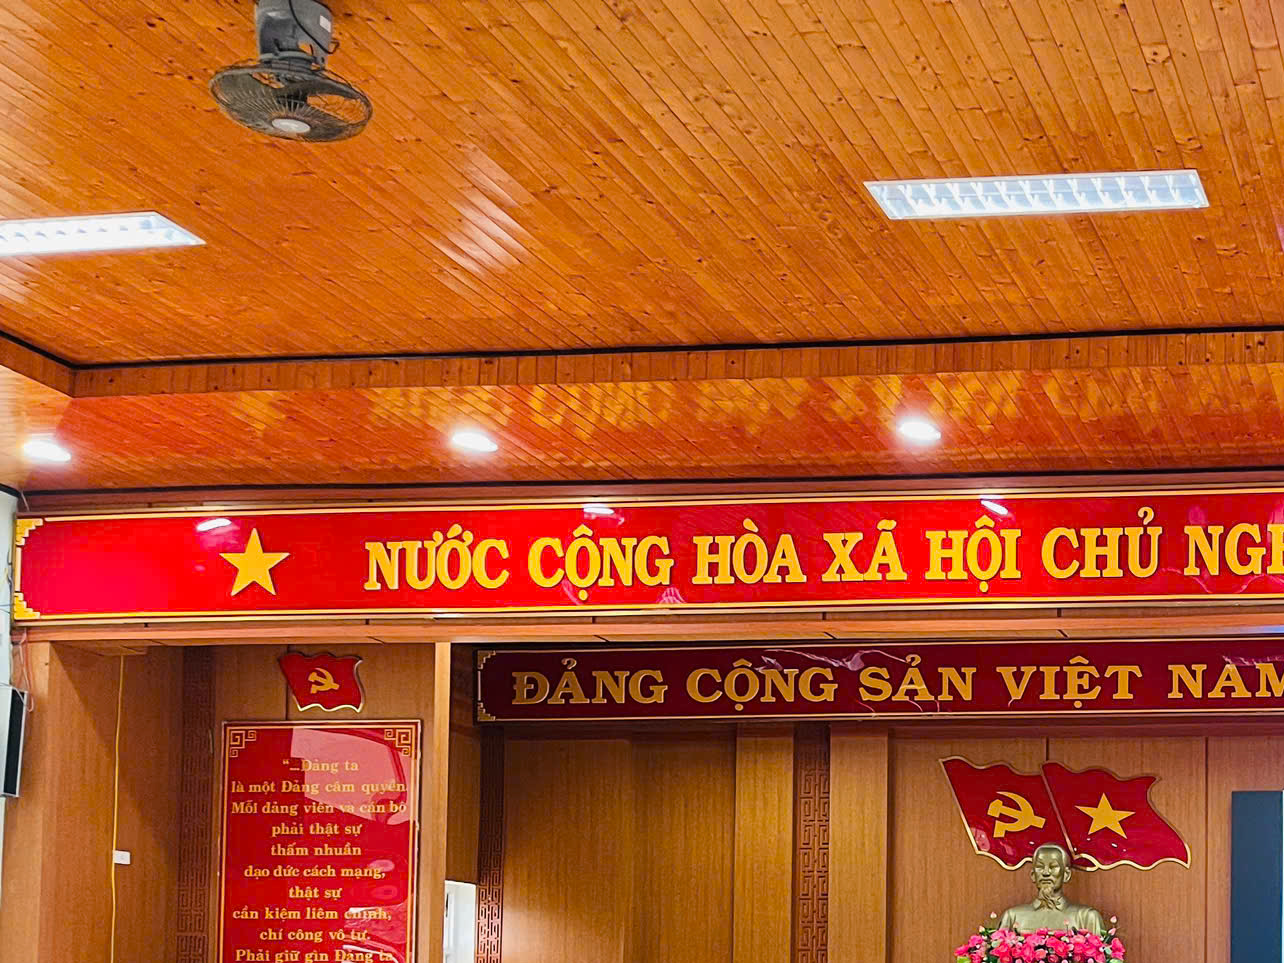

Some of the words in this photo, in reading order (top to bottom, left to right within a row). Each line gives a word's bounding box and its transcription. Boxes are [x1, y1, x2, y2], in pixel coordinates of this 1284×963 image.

[364, 523, 509, 591] NƯỚC
[528, 525, 673, 600] CỘNG
[692, 518, 806, 584] HÒA
[821, 519, 907, 582] XÃ
[925, 515, 1022, 593] HỘI
[1041, 506, 1163, 578] CHỦ
[512, 657, 668, 705] ĐẢNG
[686, 658, 838, 711] CỘNG
[857, 653, 977, 703] SẢN
[998, 655, 1142, 708] VIỆT
[231, 781, 245, 792] là
[248, 781, 276, 795] một
[281, 780, 320, 795] Đảng
[232, 800, 257, 813] Mỗi
[262, 802, 298, 816] đảng
[272, 822, 304, 837] phải
[310, 823, 339, 836] thật
[345, 824, 362, 836] sự
[271, 842, 308, 856] thấm
[314, 842, 361, 856] nhuần
[244, 865, 270, 879] đạo
[274, 865, 300, 876] đức
[303, 865, 336, 876] cách
[341, 868, 385, 879] mạng,
[289, 886, 319, 900] thật
[324, 888, 342, 900] sự
[233, 906, 258, 919] cần
[265, 907, 300, 922] kiệm
[306, 907, 338, 919] liêm
[260, 928, 283, 940] chí
[288, 929, 323, 943] công
[329, 929, 345, 940] vô
[236, 949, 270, 961] Phải
[275, 950, 300, 963] giữ
[305, 950, 328, 963] gìn
